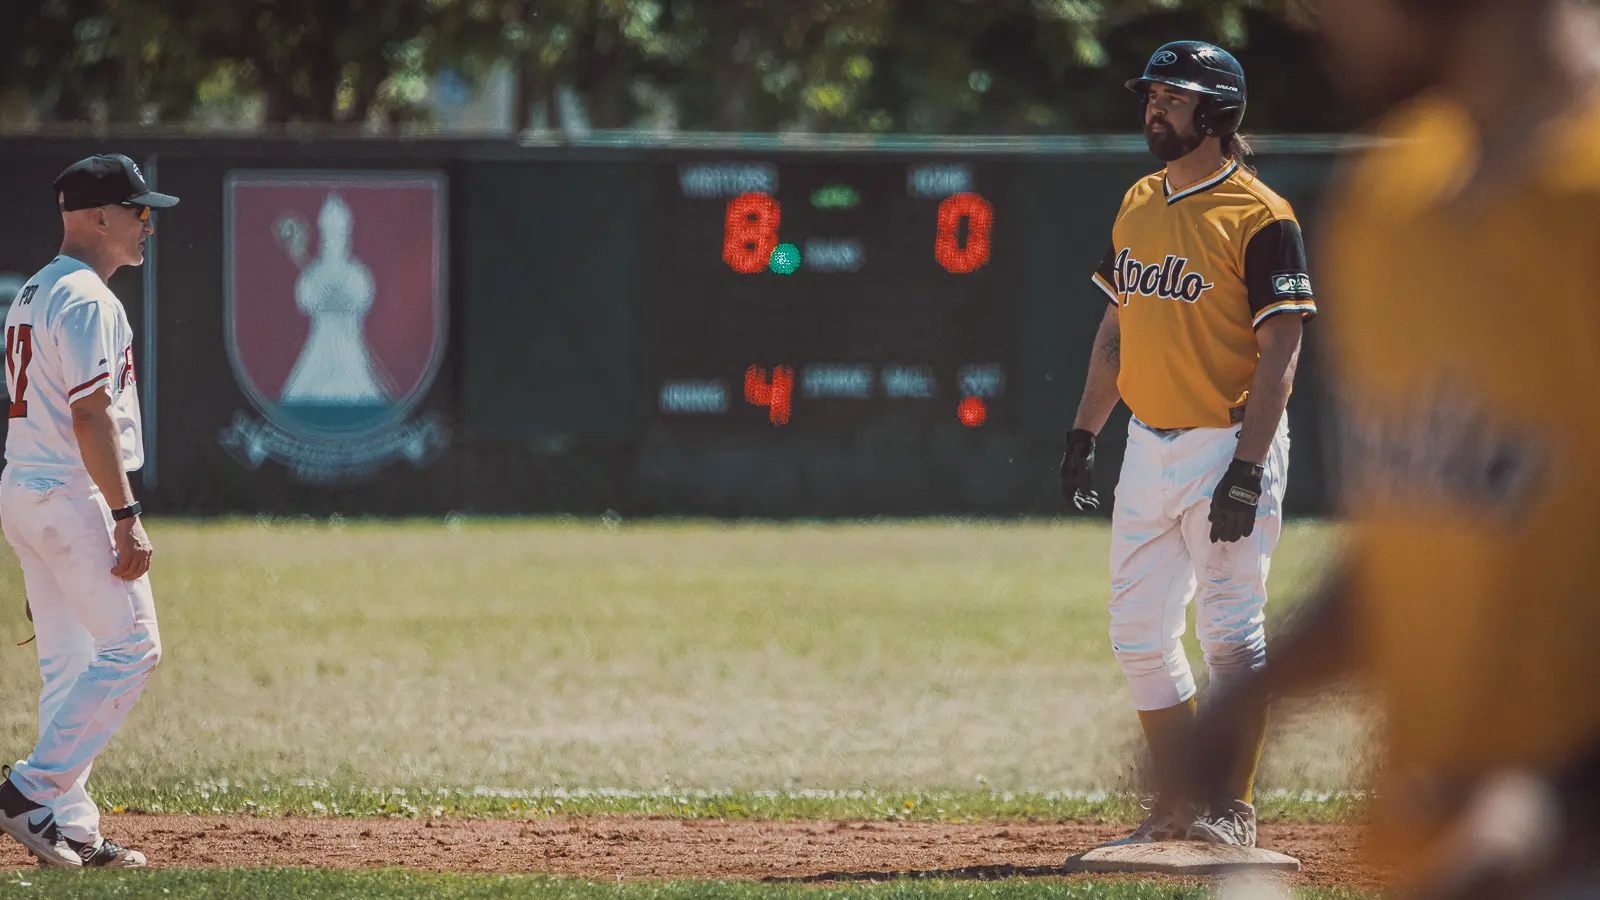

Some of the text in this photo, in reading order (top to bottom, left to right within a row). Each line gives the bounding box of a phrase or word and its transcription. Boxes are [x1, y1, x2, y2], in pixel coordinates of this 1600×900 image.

[722, 192, 780, 273] 8
[935, 192, 993, 273] 0
[1113, 247, 1214, 307] Apollo
[744, 363, 793, 425] 4
